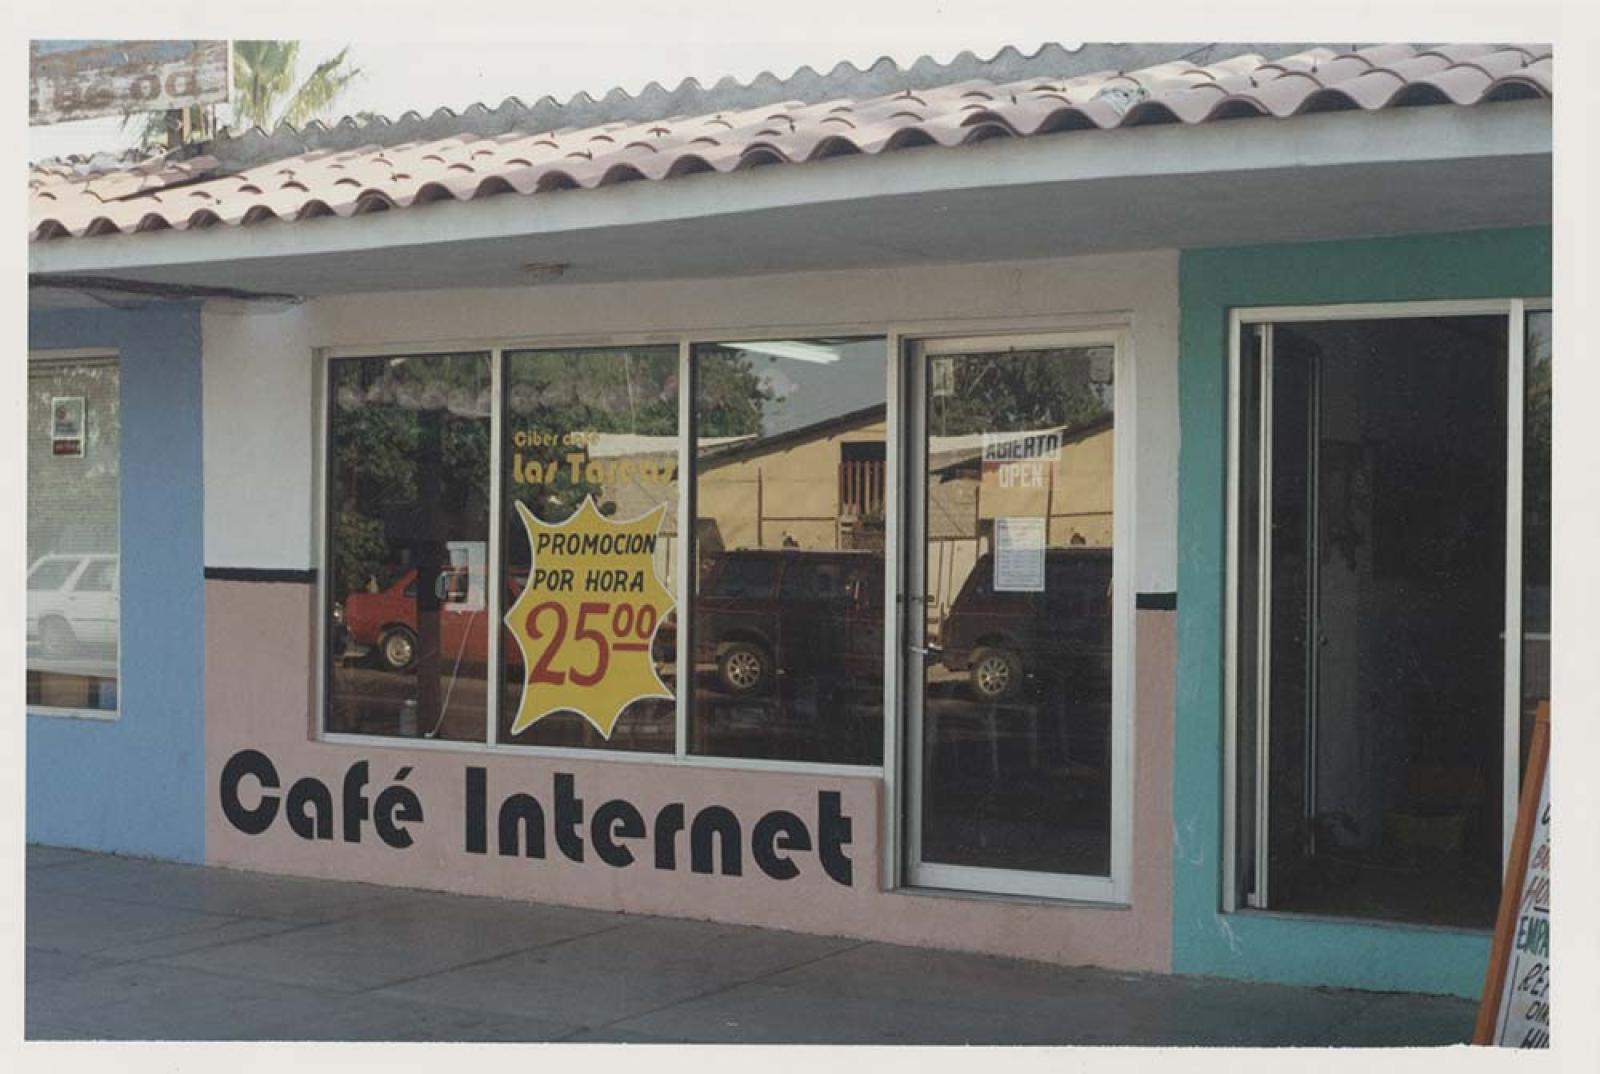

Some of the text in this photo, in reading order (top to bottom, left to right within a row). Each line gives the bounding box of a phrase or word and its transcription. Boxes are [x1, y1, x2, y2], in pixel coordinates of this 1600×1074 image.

[999, 463, 1042, 488] OPEN
[537, 533, 657, 555] PROMOCION
[533, 569, 644, 592] POR HORA
[220, 749, 853, 887] Café Internet
